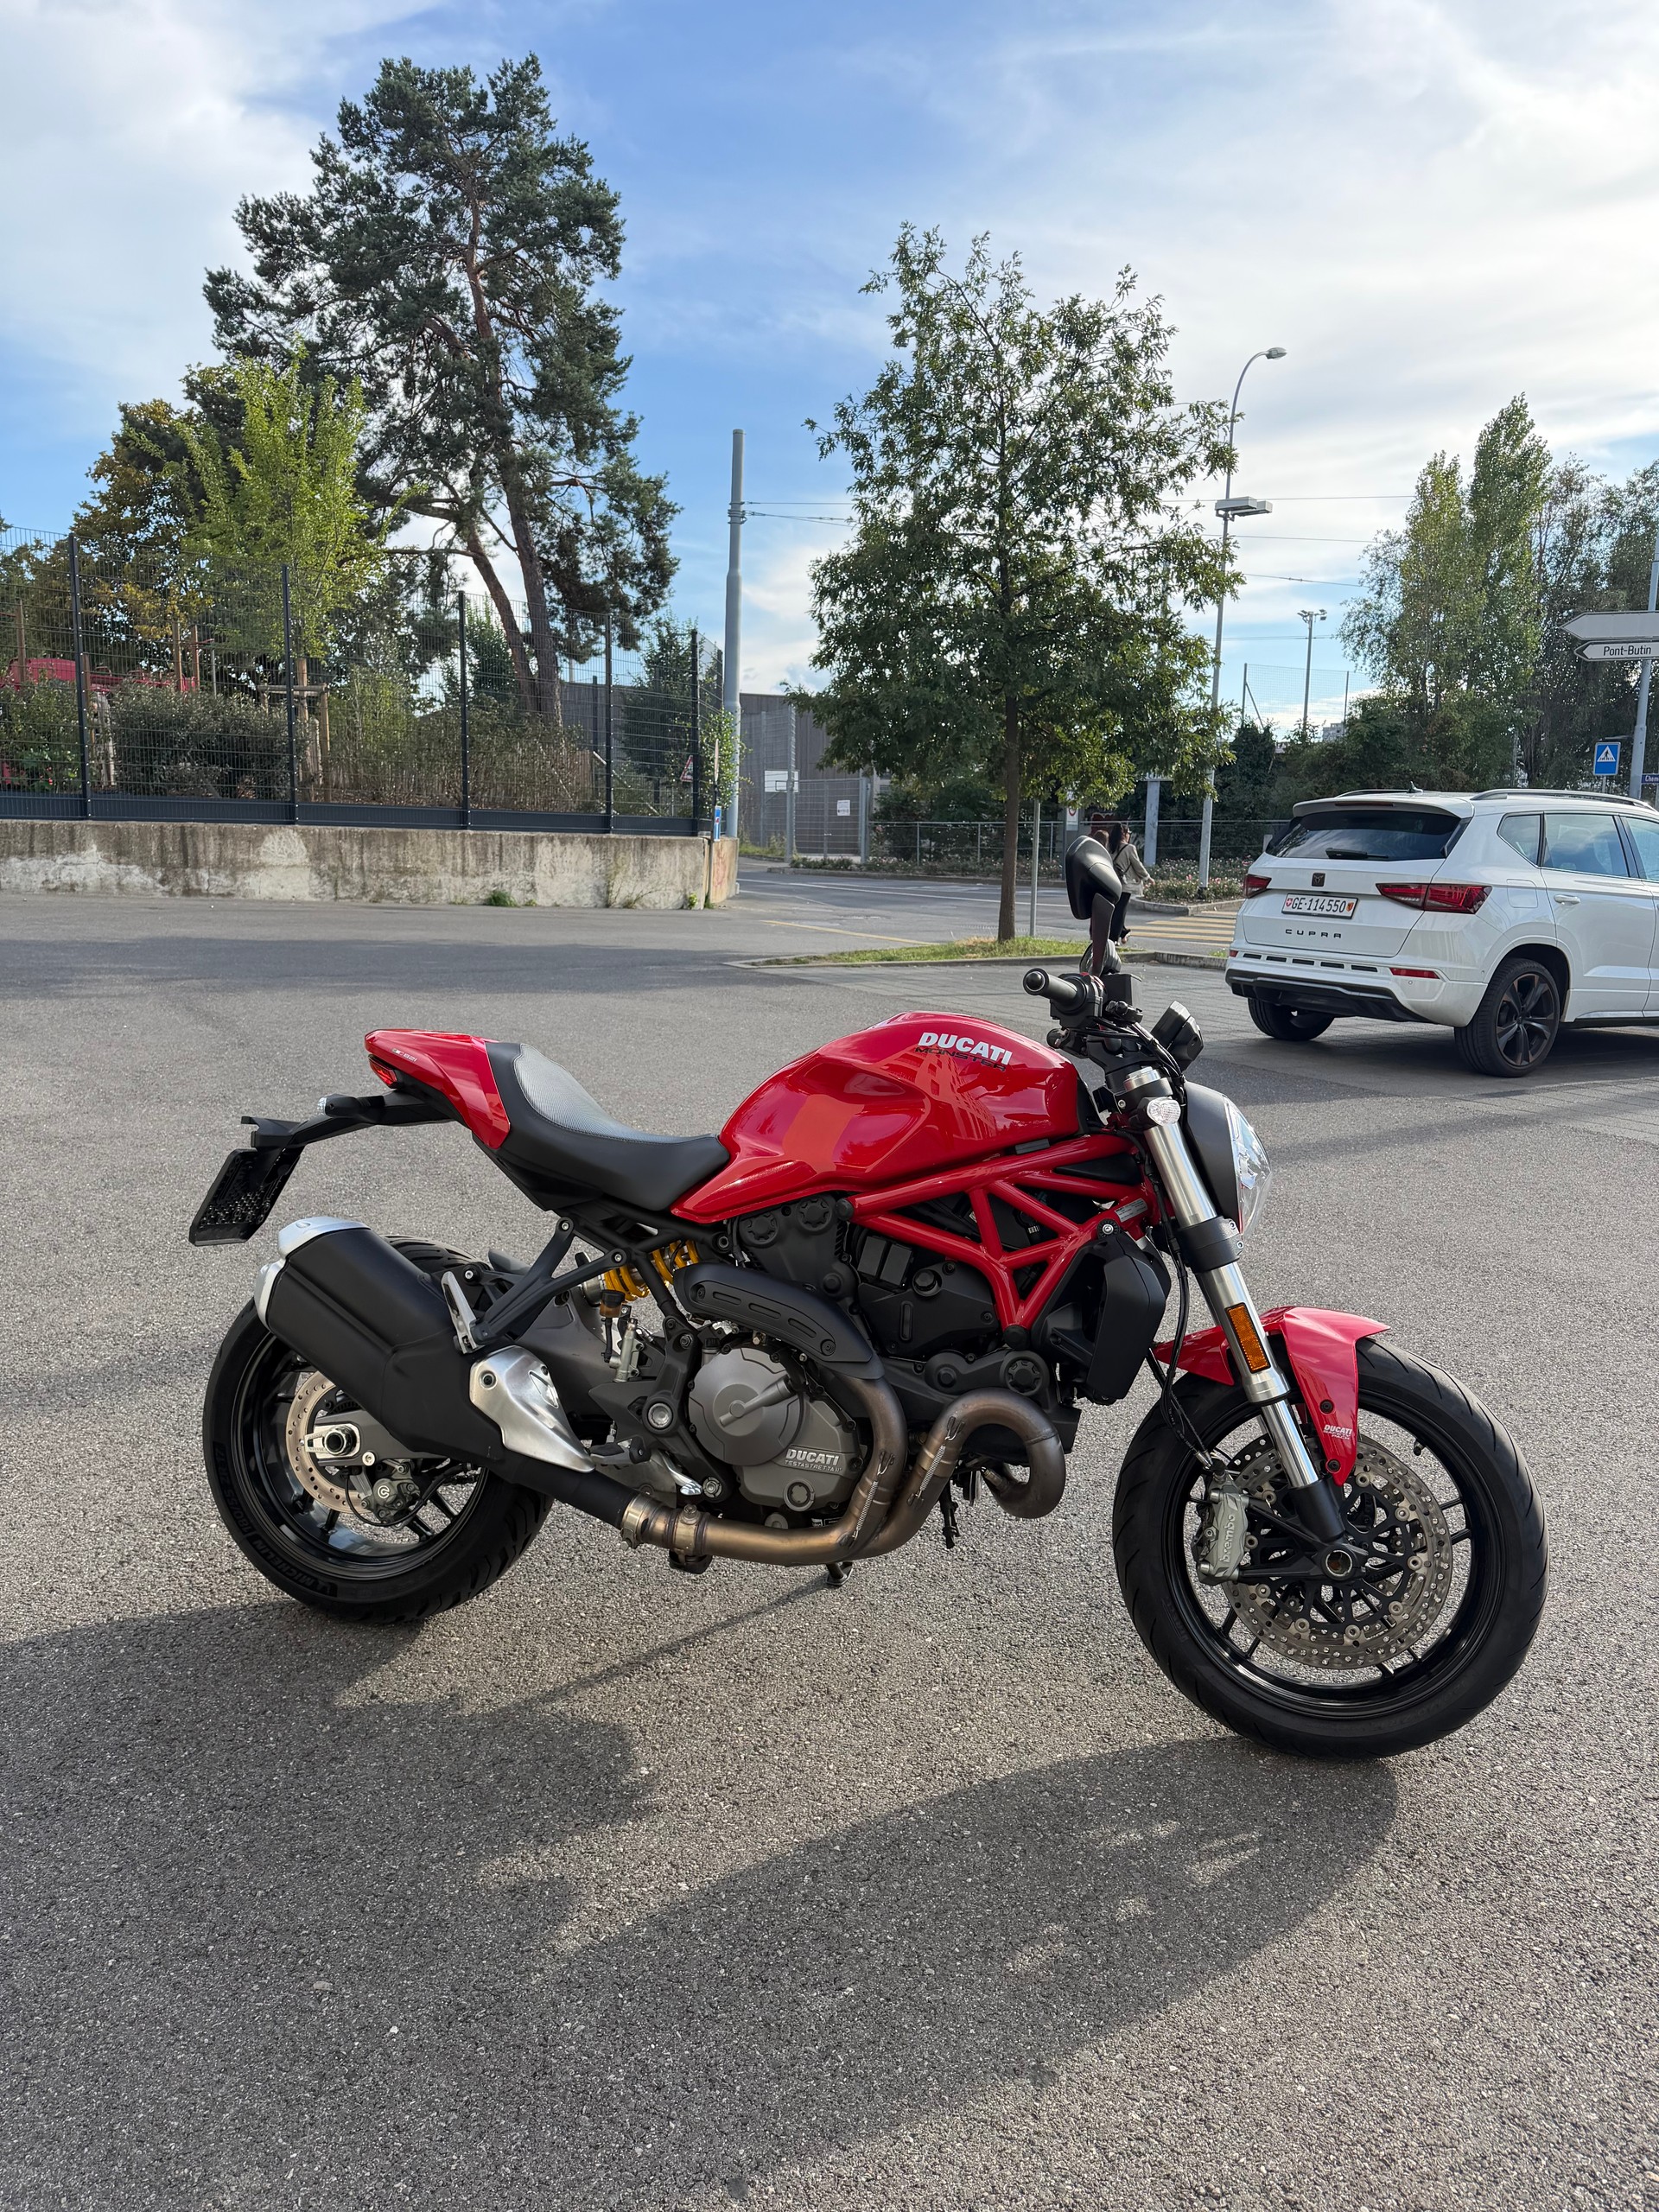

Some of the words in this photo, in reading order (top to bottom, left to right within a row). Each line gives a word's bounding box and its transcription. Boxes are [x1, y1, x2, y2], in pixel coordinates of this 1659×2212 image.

[1604, 645, 1651, 657] Pont-Butin
[1285, 929, 1342, 938] CUPRA
[918, 1032, 1013, 1065] DUCATI
[915, 1046, 1007, 1072] MONSTER
[1324, 1424, 1353, 1435] DUCATI
[785, 1448, 840, 1466] DUCATI
[785, 1460, 835, 1471] TESTASTRETTA
[1219, 1514, 1236, 1563] brembo
[252, 1539, 318, 1588] MICHELIN
